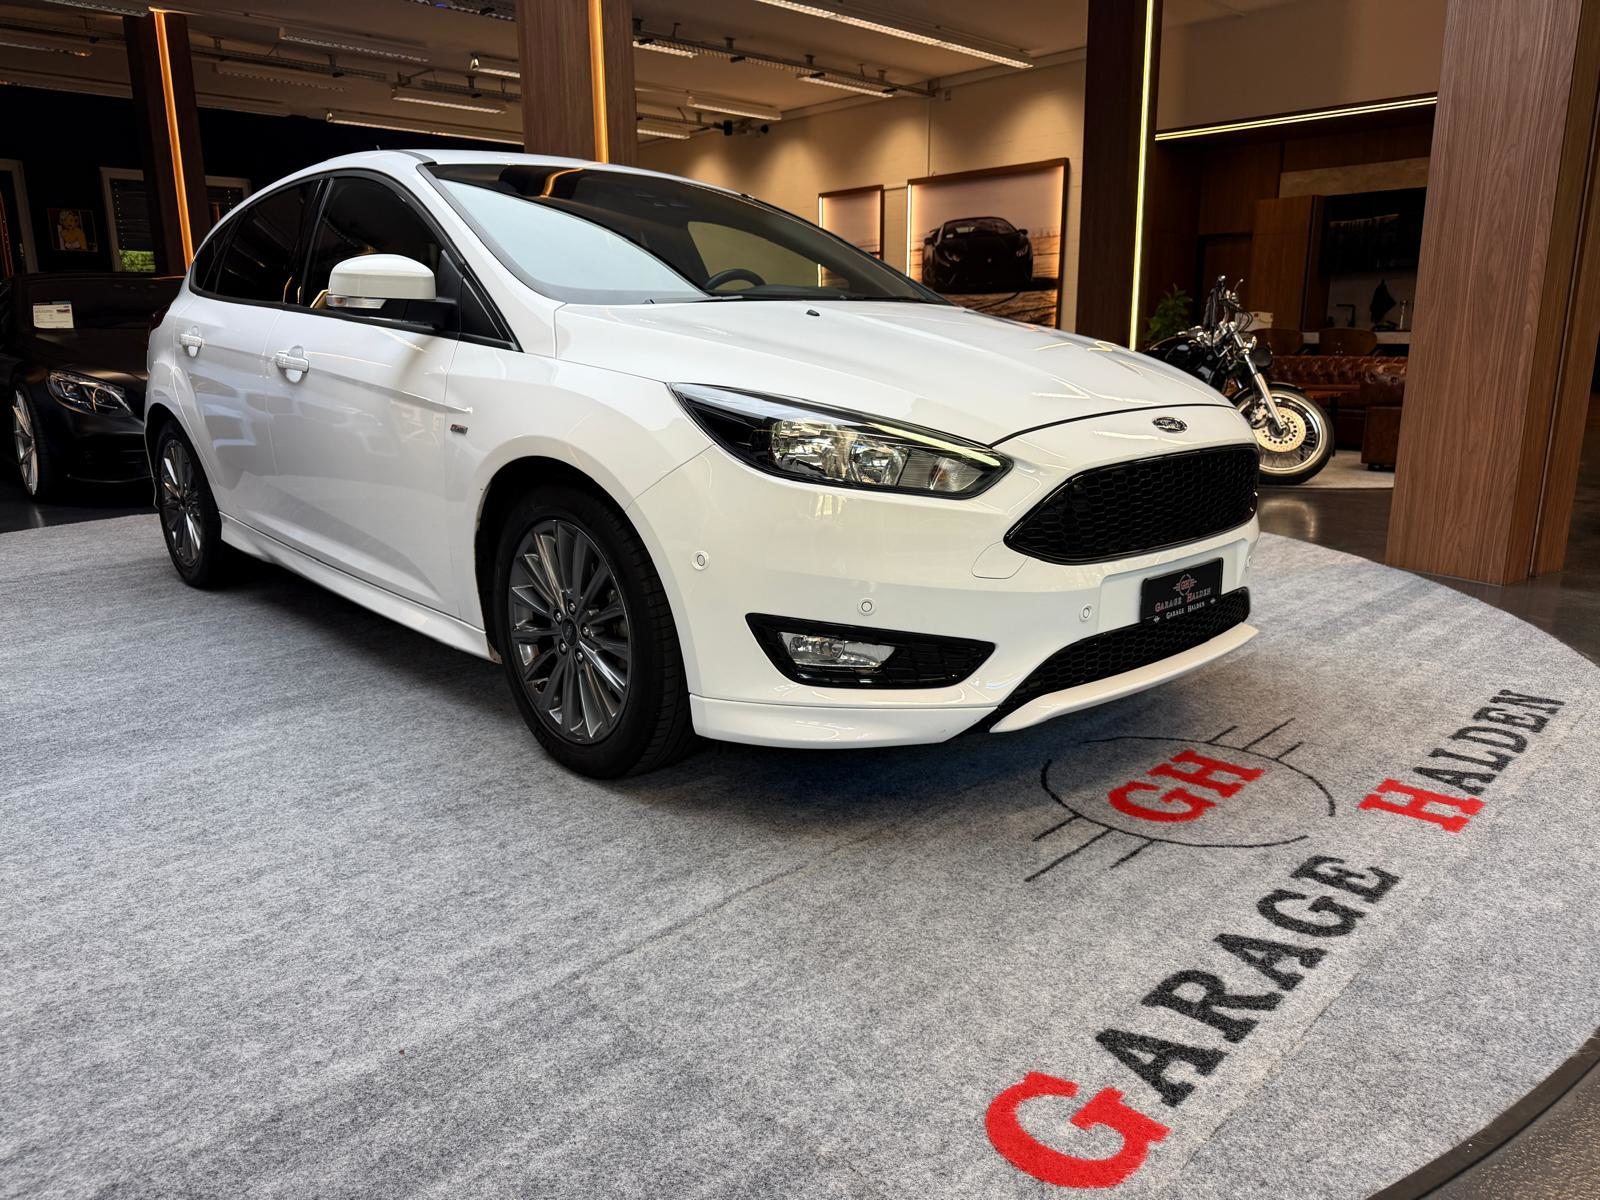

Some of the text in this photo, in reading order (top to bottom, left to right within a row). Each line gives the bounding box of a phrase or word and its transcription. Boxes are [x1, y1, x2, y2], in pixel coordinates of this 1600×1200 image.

[1154, 587, 1212, 613] GARAGE HALDEN
[1107, 750, 1265, 823] GH
[984, 688, 1566, 1190] GARAGE HALDEN
